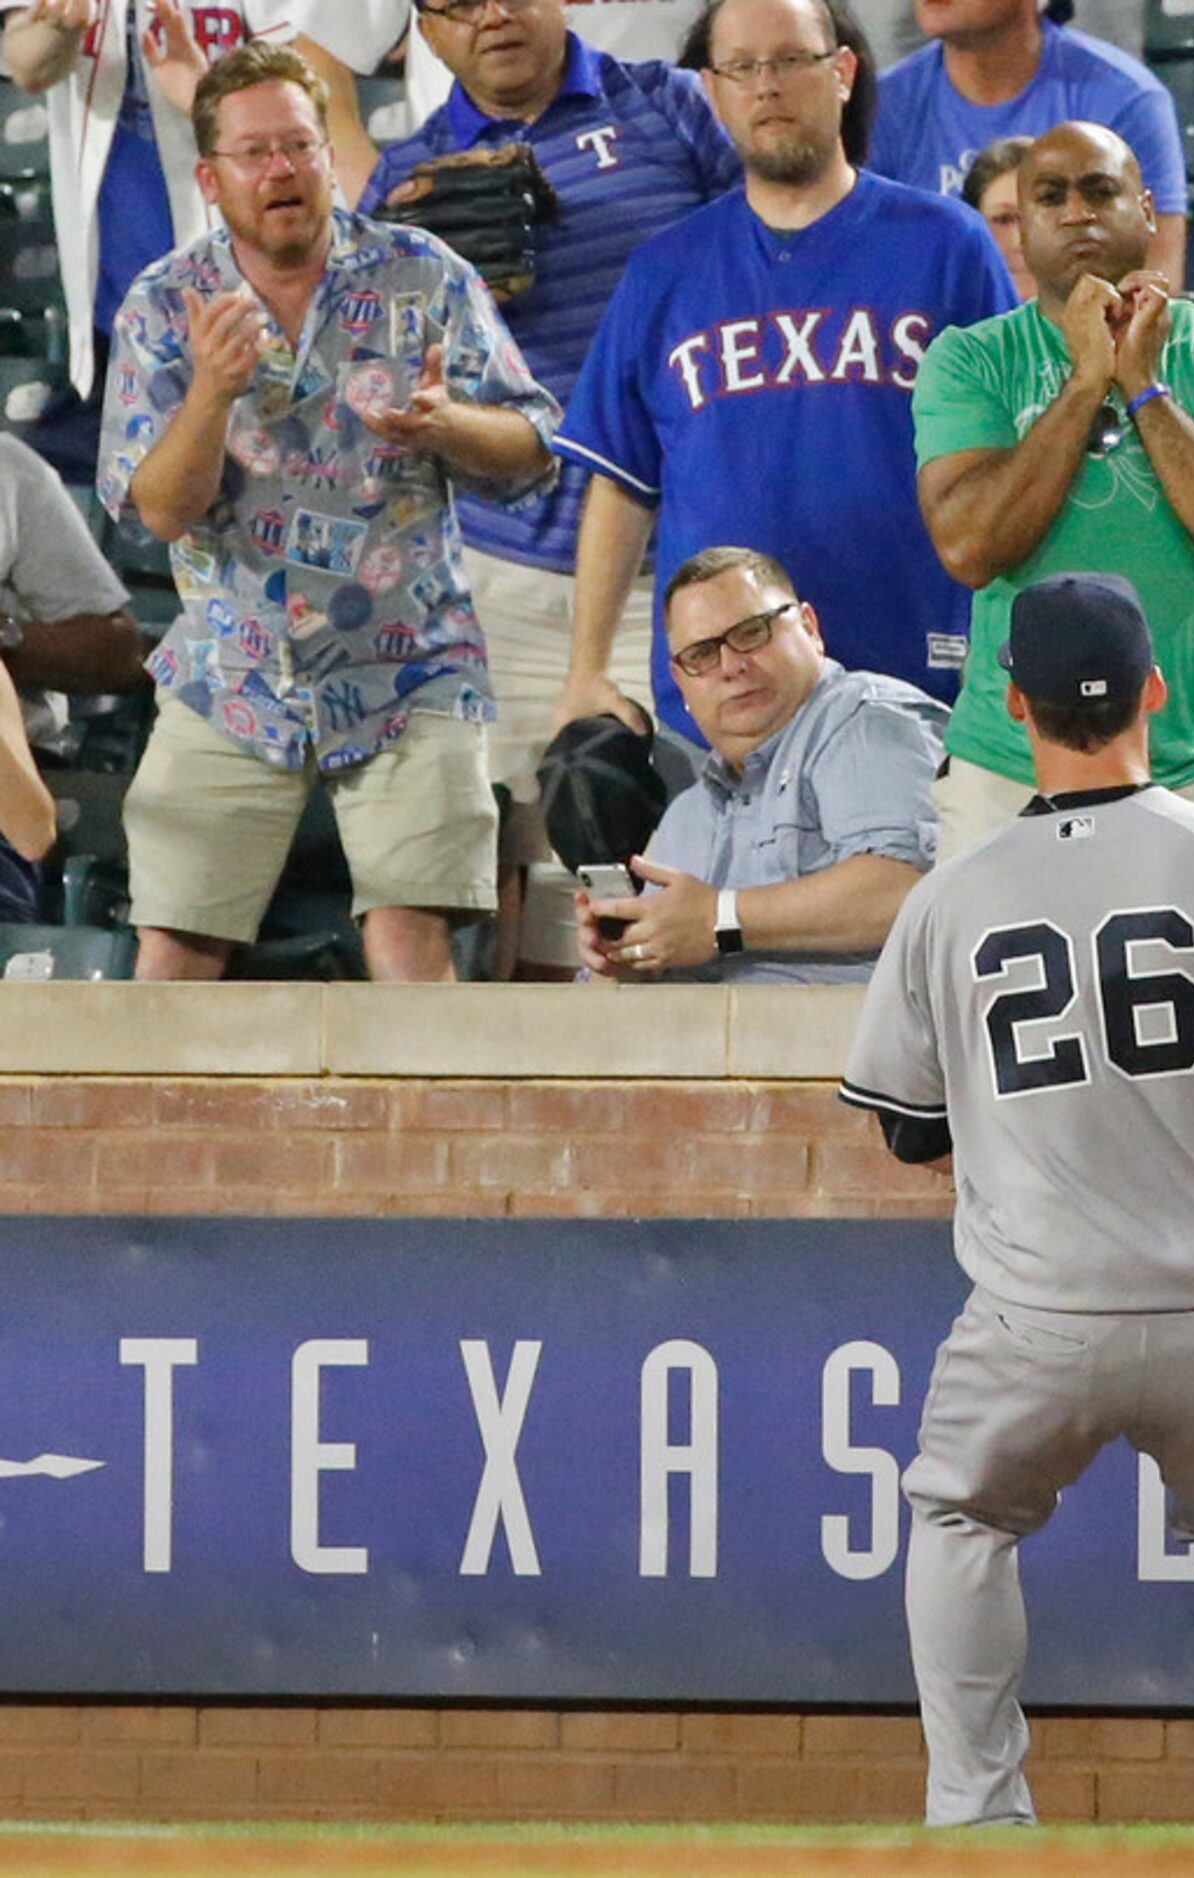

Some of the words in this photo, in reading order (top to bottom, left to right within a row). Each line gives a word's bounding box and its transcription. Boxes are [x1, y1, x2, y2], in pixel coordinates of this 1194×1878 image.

[575, 125, 620, 170] T
[667, 308, 928, 410] TEXAS
[119, 1337, 901, 1581] TEXAS
